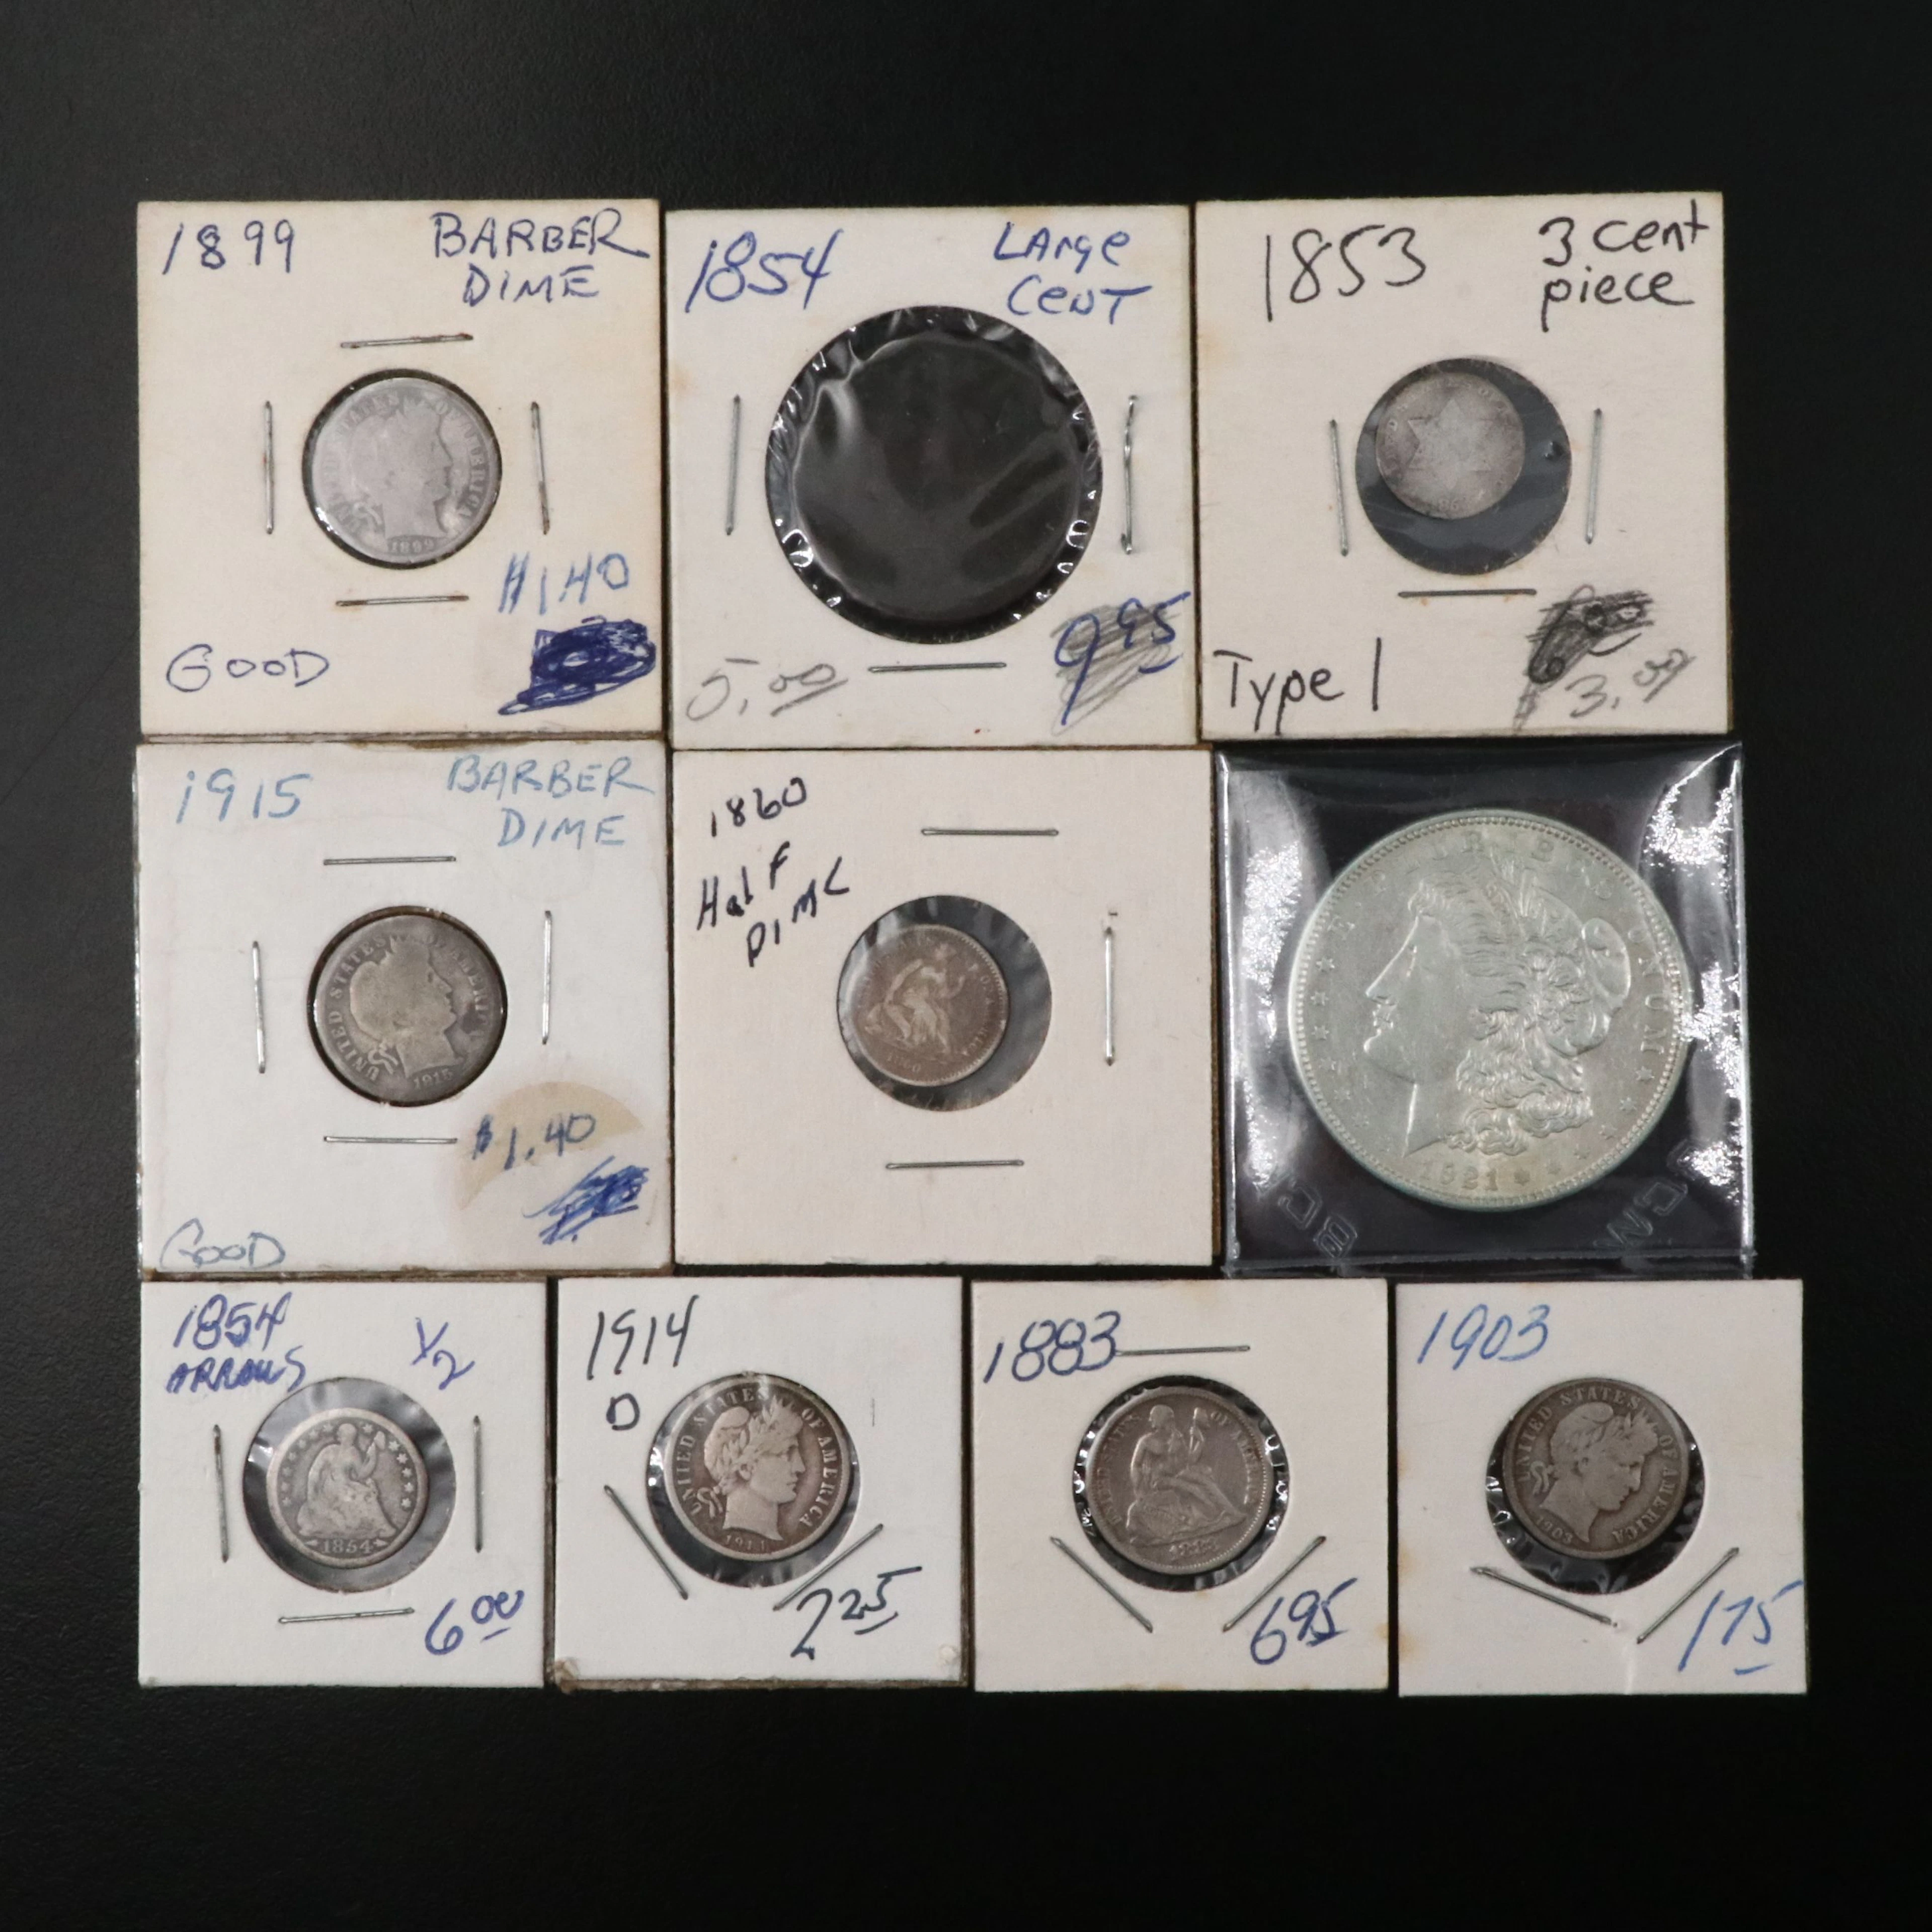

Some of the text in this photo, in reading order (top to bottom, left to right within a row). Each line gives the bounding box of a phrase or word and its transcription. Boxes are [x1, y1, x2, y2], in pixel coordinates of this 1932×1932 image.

[163, 219, 296, 275] 1899
[430, 208, 650, 260] BARBER
[1539, 216, 1575, 267] 3
[462, 264, 599, 306] DIME
[685, 229, 844, 312] 1854
[1265, 224, 1426, 323] 1853
[1541, 265, 1696, 333] piece
[166, 643, 331, 692] GOOD
[1214, 649, 1344, 736] Type
[176, 768, 310, 824] 1915
[447, 753, 655, 799] BARBER
[497, 808, 625, 849] DIME
[711, 777, 808, 837] 1860
[326, 929, 386, 999] STATES
[326, 1010, 382, 1082] UNITED
[173, 1292, 293, 1351] 1854
[586, 1294, 699, 1381] 1914
[983, 1311, 1121, 1383] 1883
[1417, 1303, 1551, 1371] 1903
[801, 1408, 826, 1430] OF
[799, 1436, 838, 1527] AMERICA
[1515, 1386, 1679, 1545] UNITED STATES OF AMERICA
[323, 1539, 374, 1554] 1854
